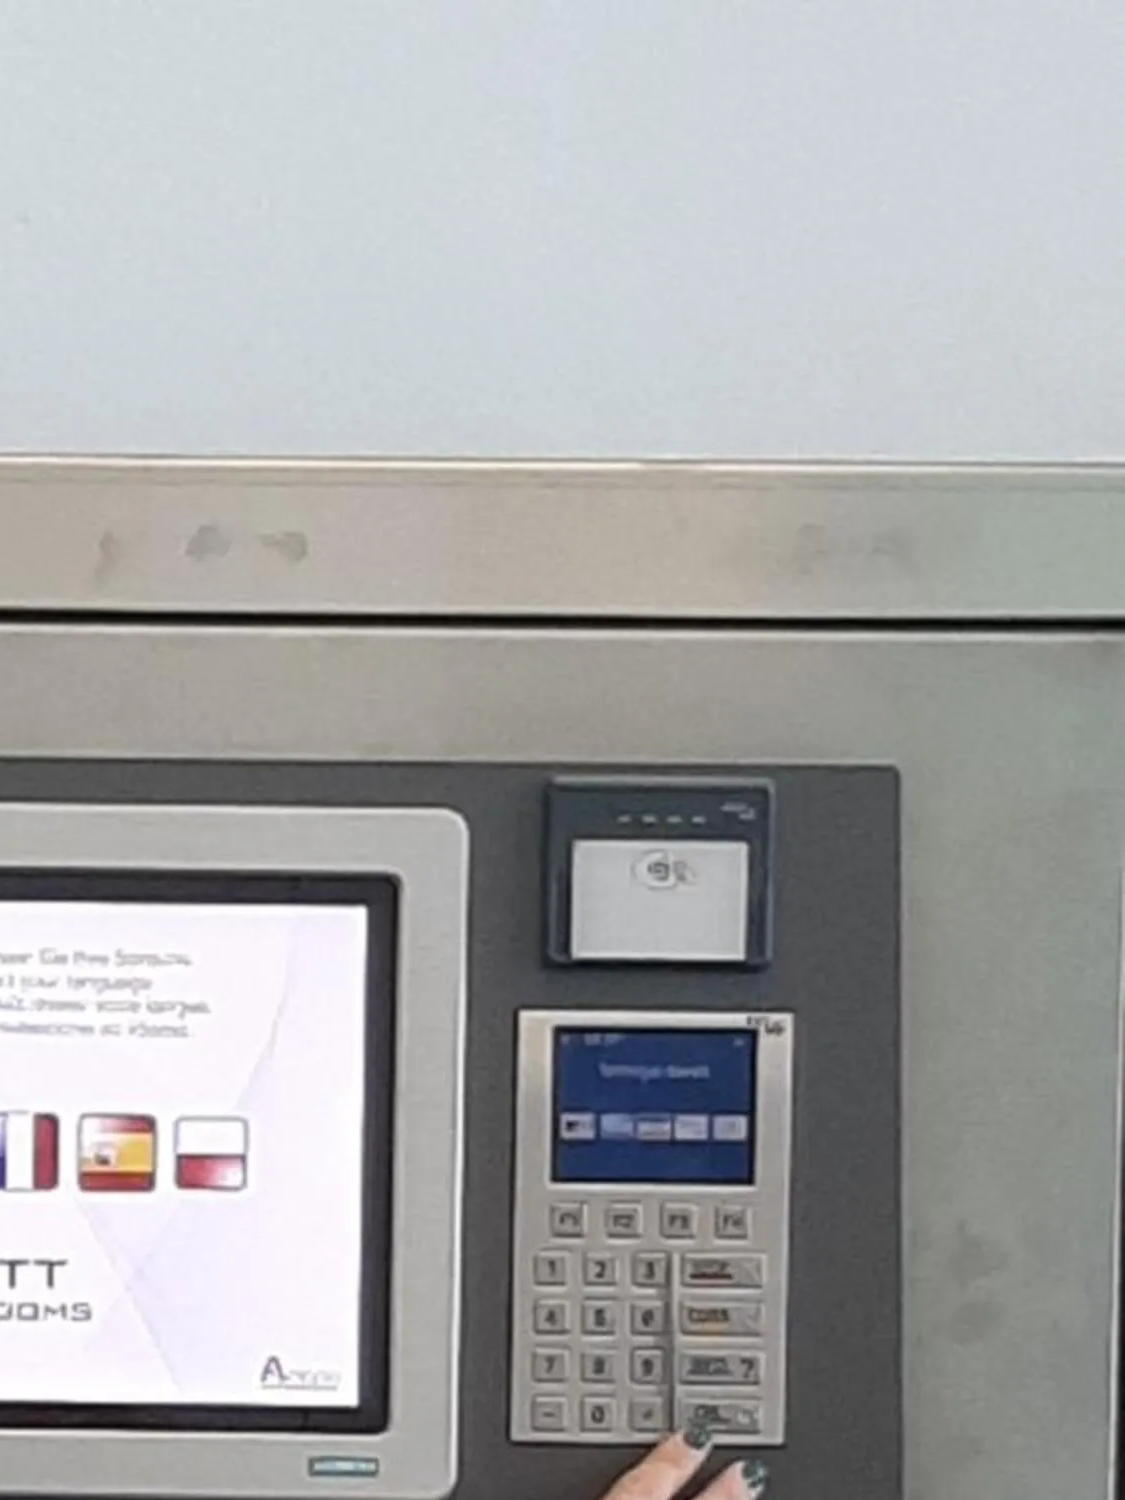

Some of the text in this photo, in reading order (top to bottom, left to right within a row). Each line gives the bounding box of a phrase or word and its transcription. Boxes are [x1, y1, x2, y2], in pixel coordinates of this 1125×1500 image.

[547, 1259, 557, 1277] 1
[594, 1260, 607, 1279] 2
[545, 1309, 557, 1327] 4
[545, 1356, 557, 1375] 7
[593, 1356, 606, 1376] 8
[591, 1404, 605, 1424] 0
